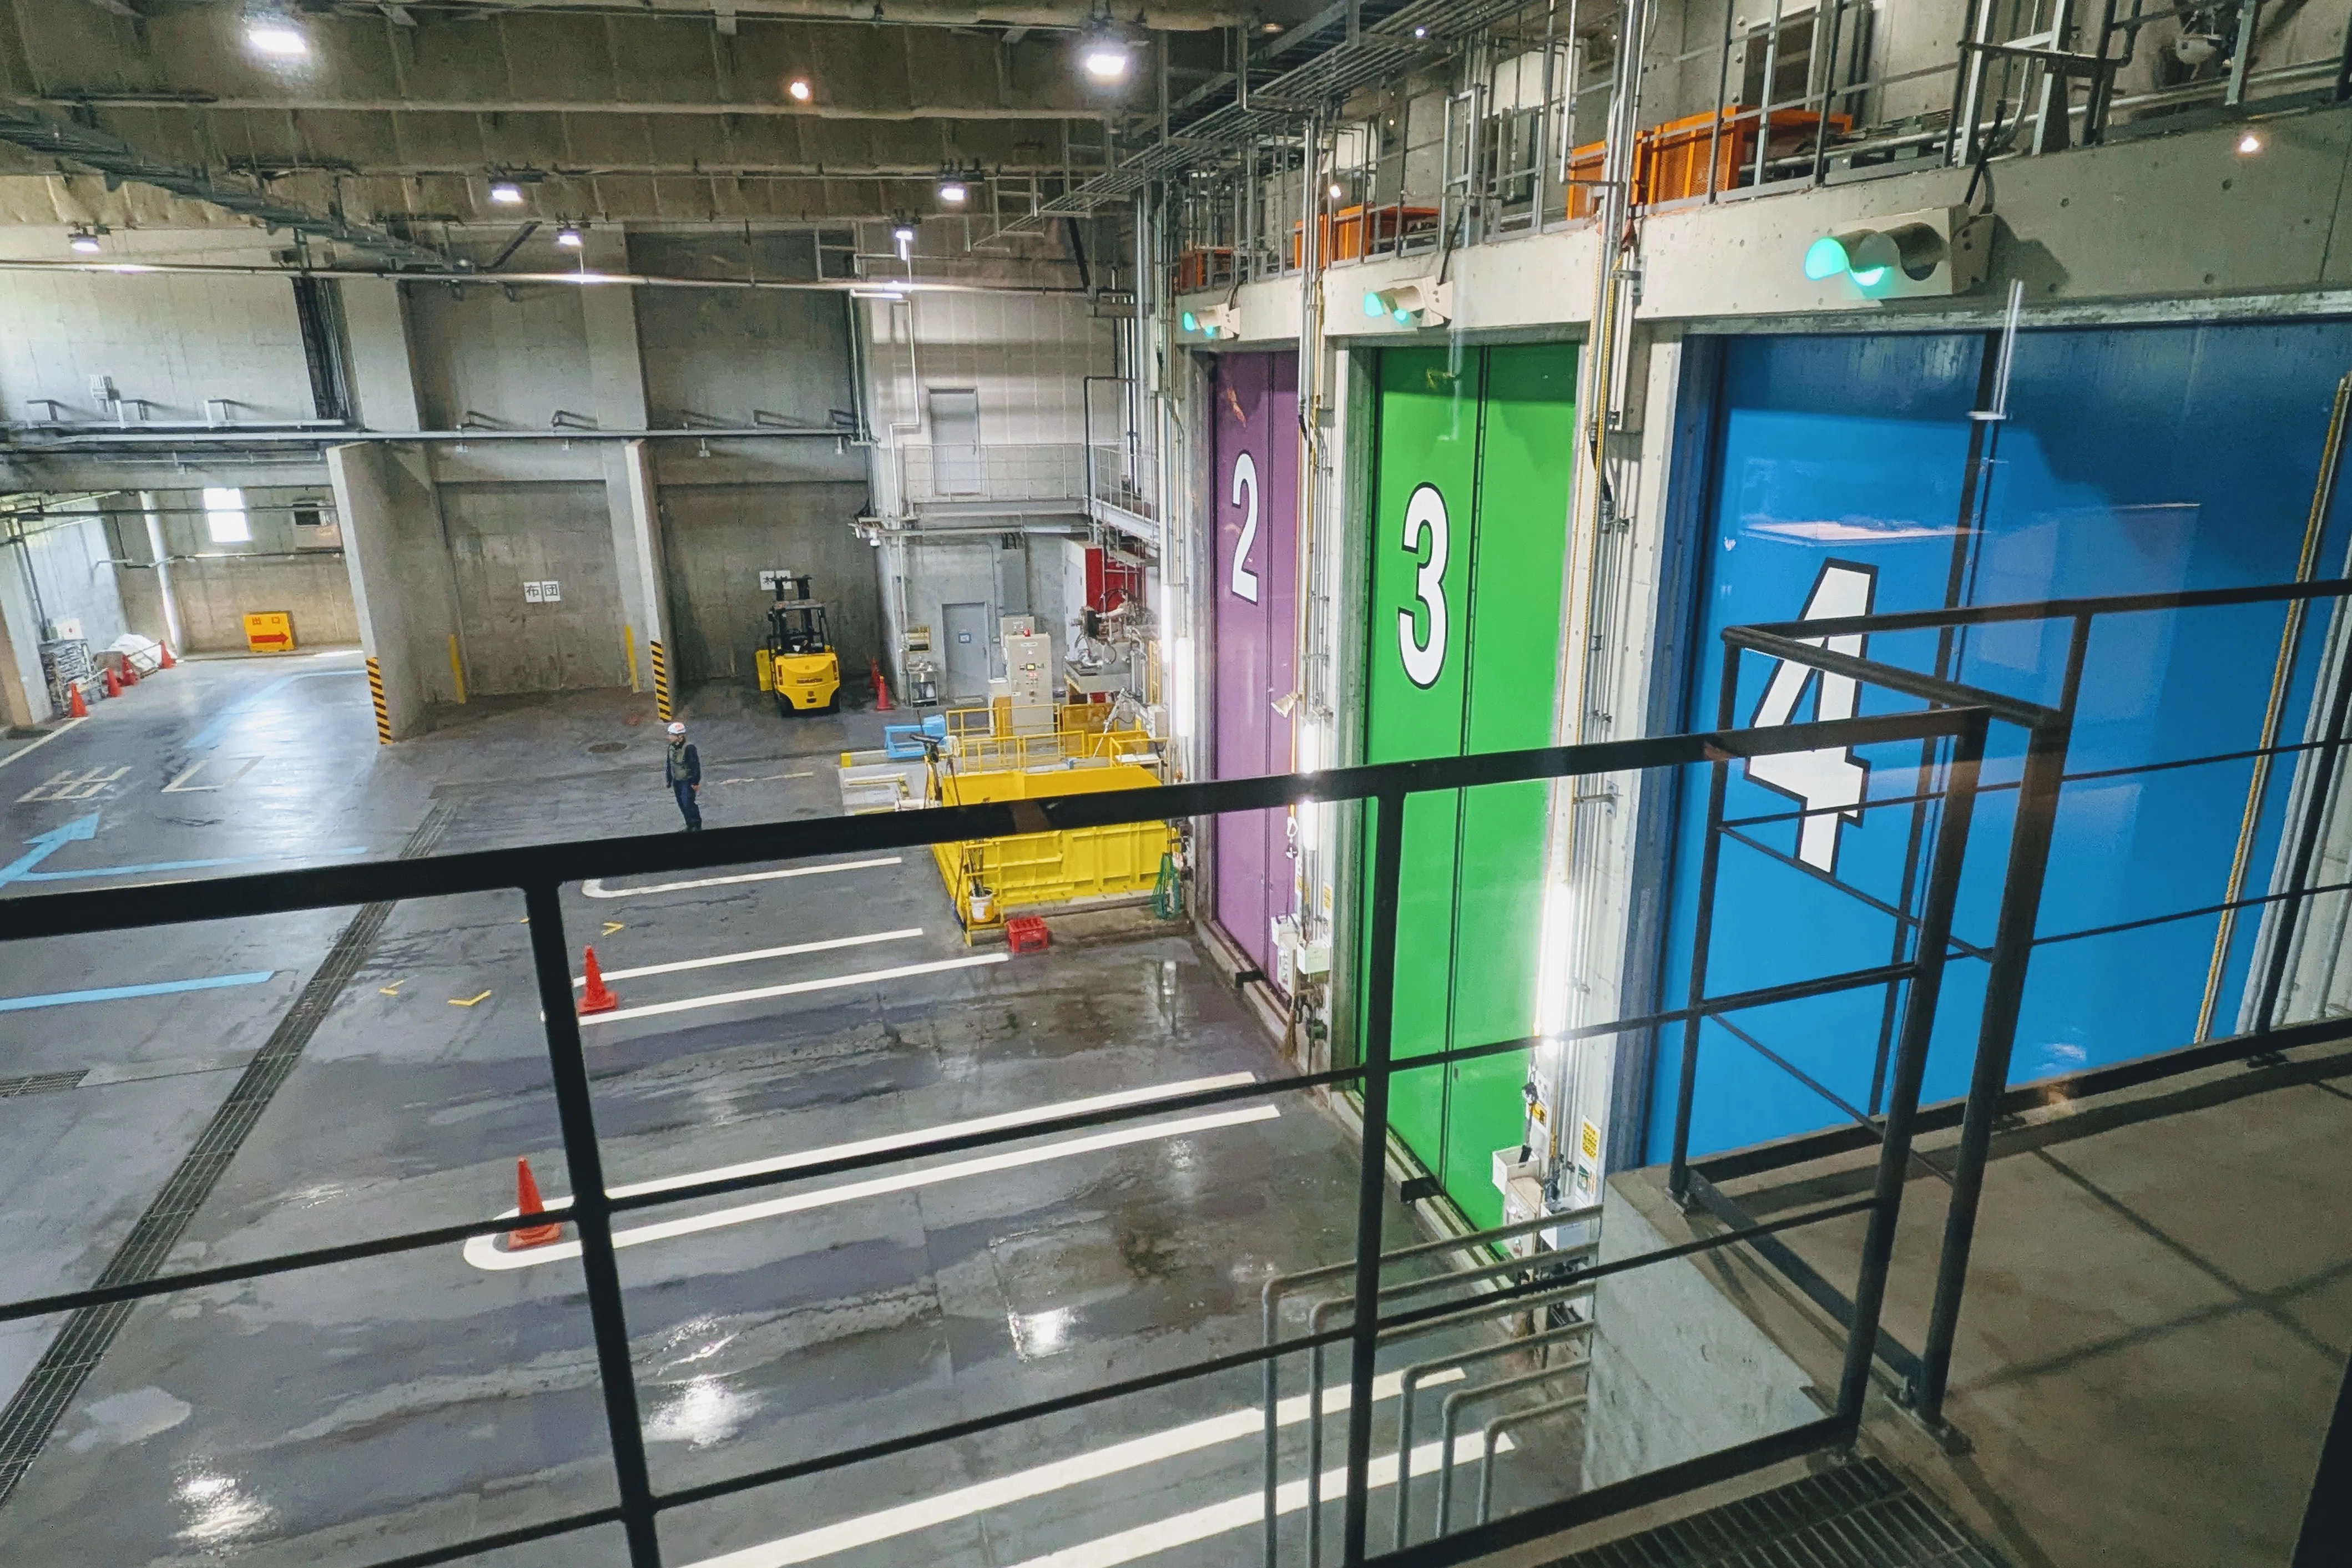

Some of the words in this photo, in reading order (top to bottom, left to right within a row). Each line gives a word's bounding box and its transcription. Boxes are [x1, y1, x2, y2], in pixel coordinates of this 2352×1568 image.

[525, 584, 558, 598] 布団
[1231, 449, 1258, 605] 2
[1398, 482, 1450, 690] 3
[251, 616, 280, 625] 出口
[1744, 557, 1879, 879] 4
